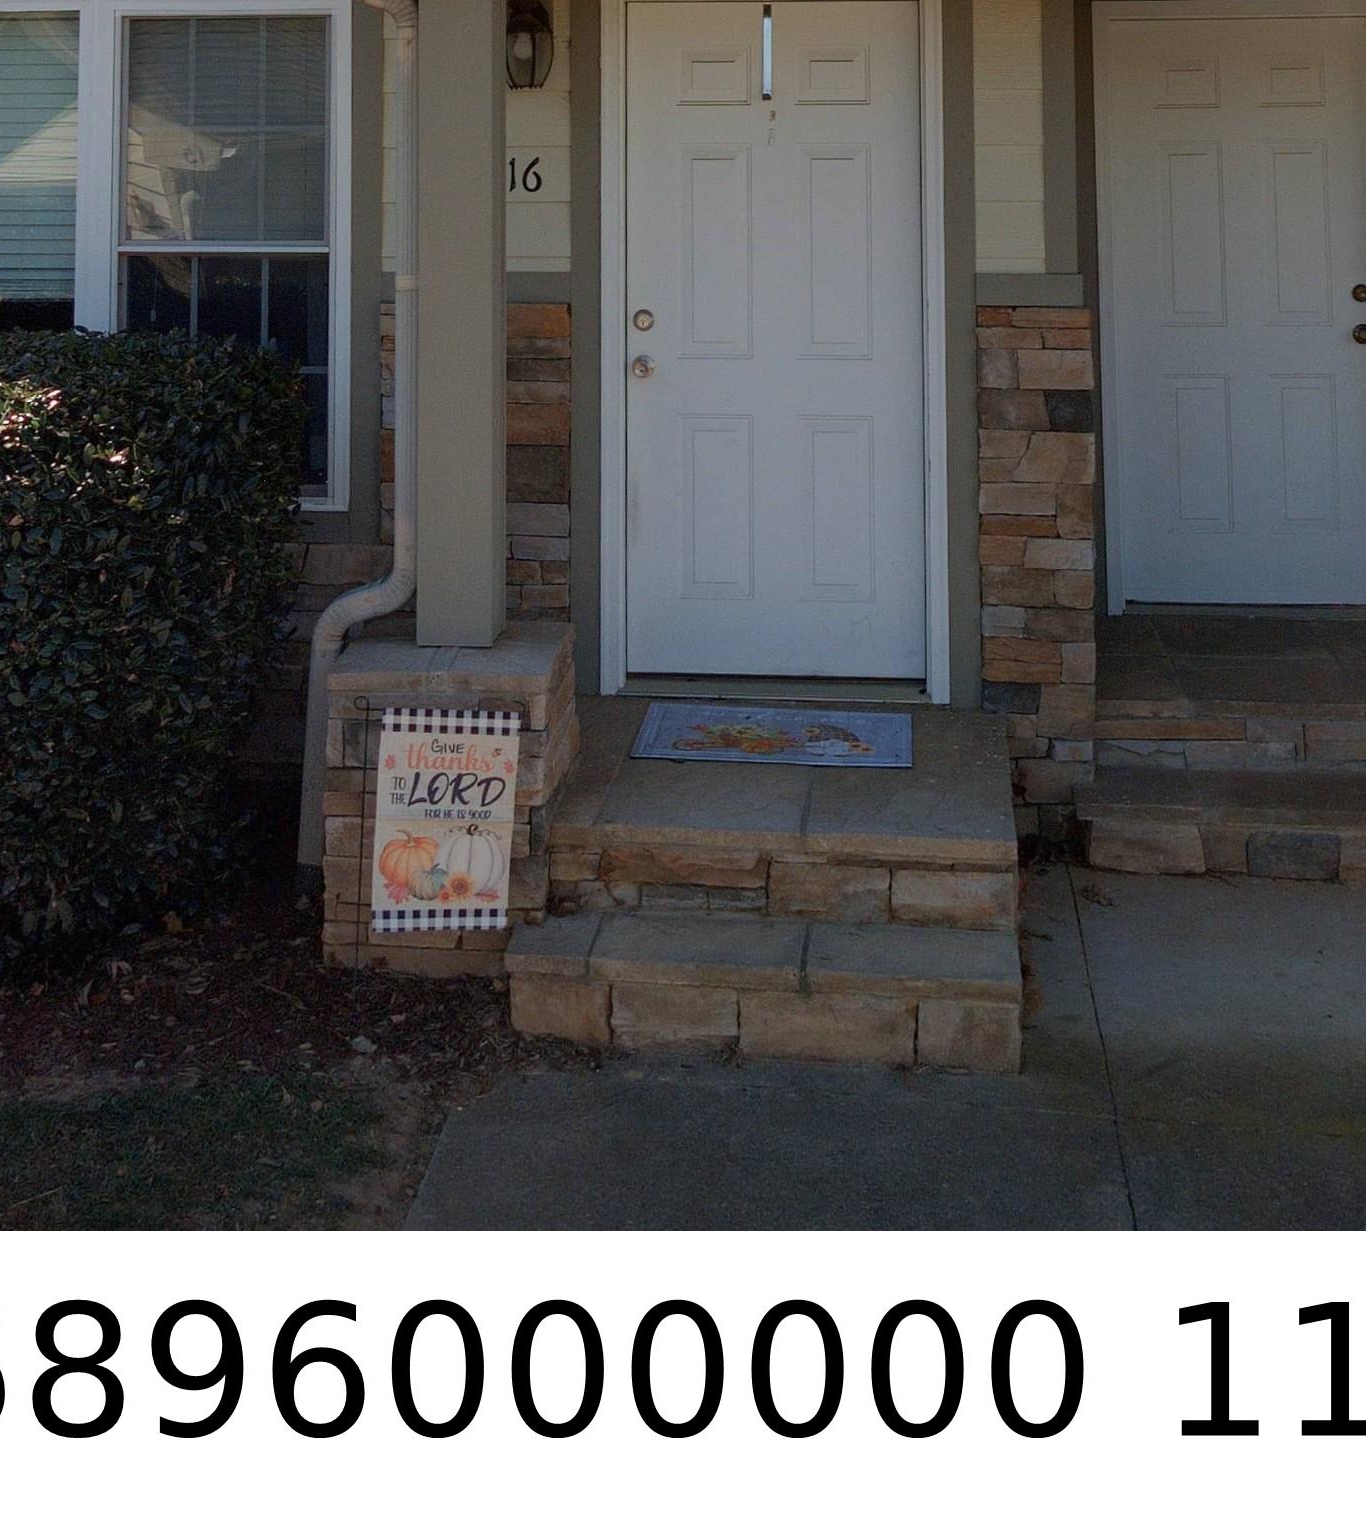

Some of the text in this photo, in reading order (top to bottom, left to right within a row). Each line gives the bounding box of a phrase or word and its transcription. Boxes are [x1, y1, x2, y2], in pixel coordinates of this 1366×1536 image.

[510, 156, 542, 192] 16
[431, 738, 465, 754] GIVE
[405, 743, 493, 773] thanks
[389, 772, 506, 807] THE LORD
[391, 776, 406, 790] TO
[425, 808, 441, 819] FOR
[443, 809, 452, 819] HE
[457, 809, 466, 819] IS
